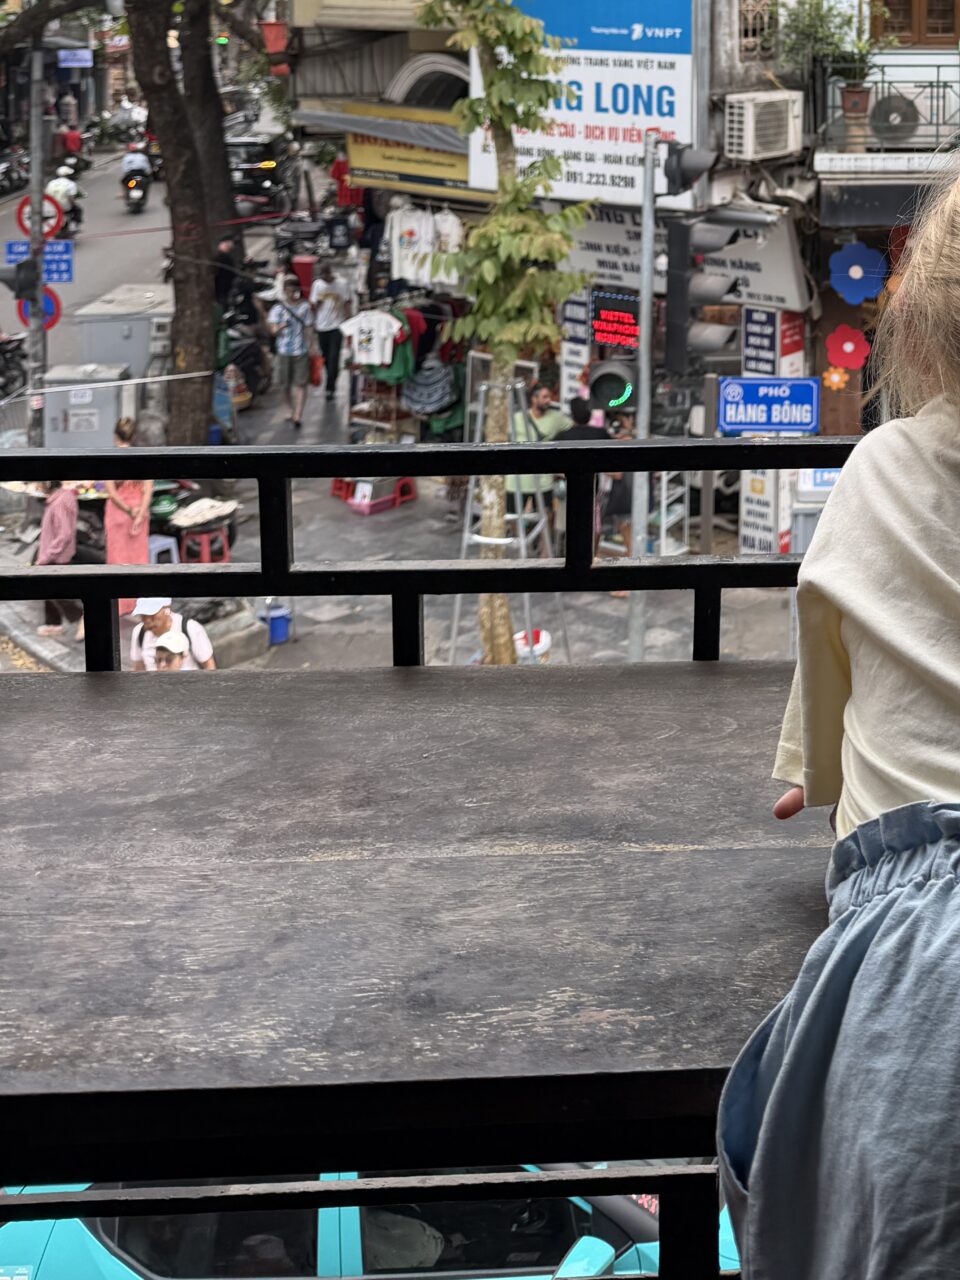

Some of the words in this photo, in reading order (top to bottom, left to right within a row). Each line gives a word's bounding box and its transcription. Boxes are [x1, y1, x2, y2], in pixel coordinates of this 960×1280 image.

[645, 27, 682, 39] VNPT
[595, 82, 675, 118] LONG
[758, 382, 791, 398] PHỐ
[726, 399, 768, 423] HÀNG
[771, 400, 812, 423] BÔNG
